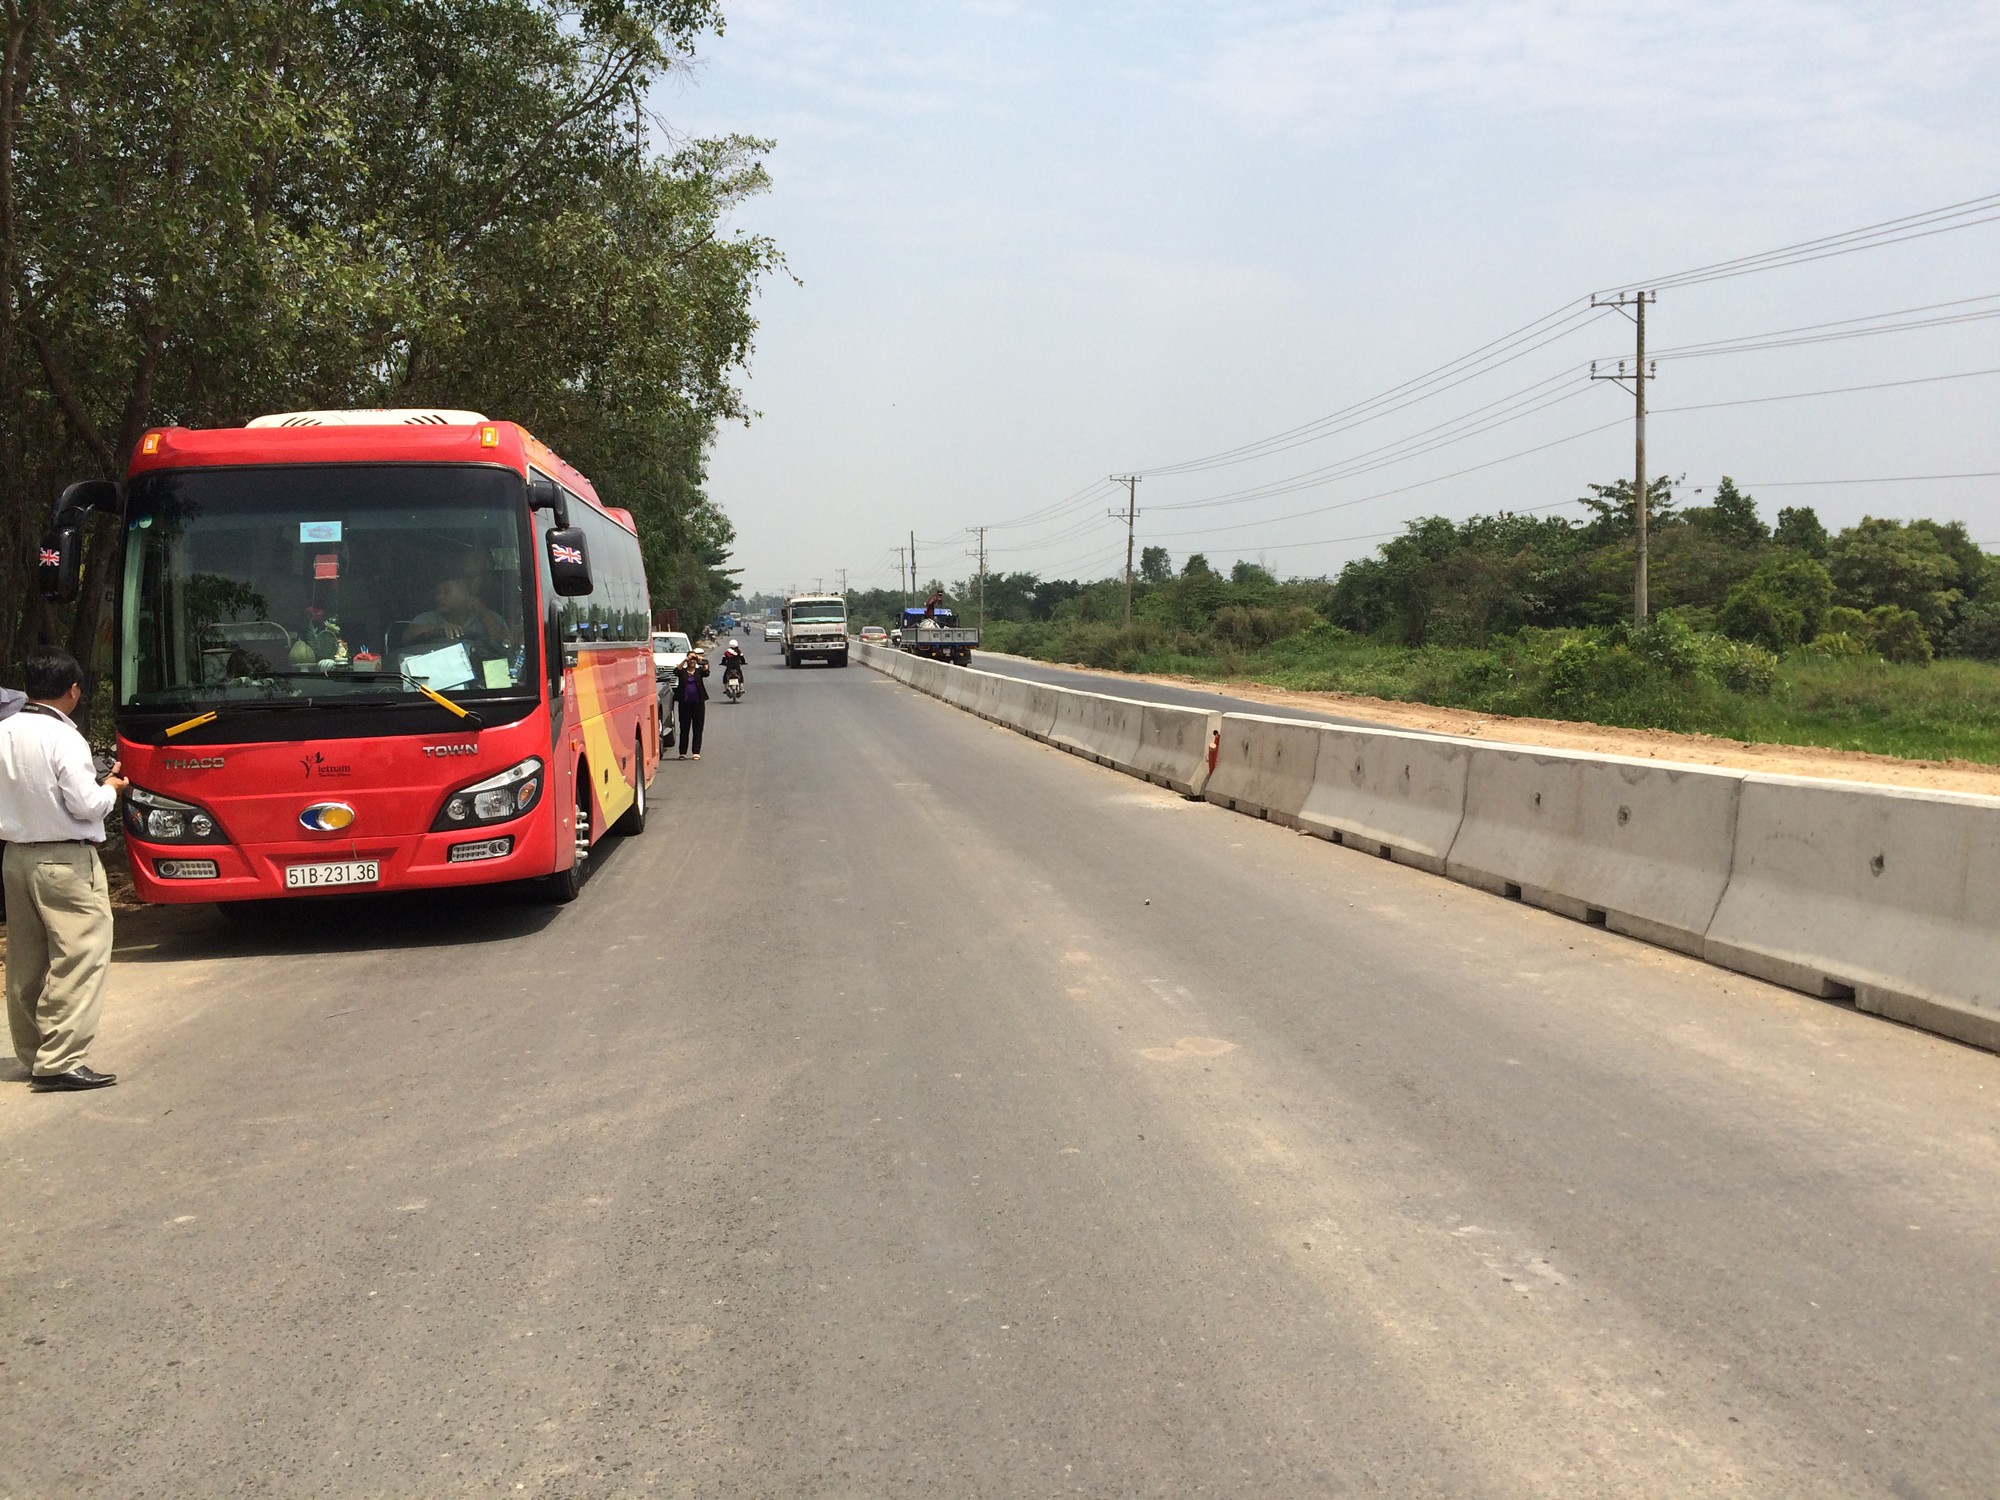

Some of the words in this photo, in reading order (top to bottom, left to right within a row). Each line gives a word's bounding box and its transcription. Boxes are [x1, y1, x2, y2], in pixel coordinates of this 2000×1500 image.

[422, 743, 478, 757] TOWN
[162, 757, 225, 770] THACO
[289, 864, 376, 885] 51B-231.36
